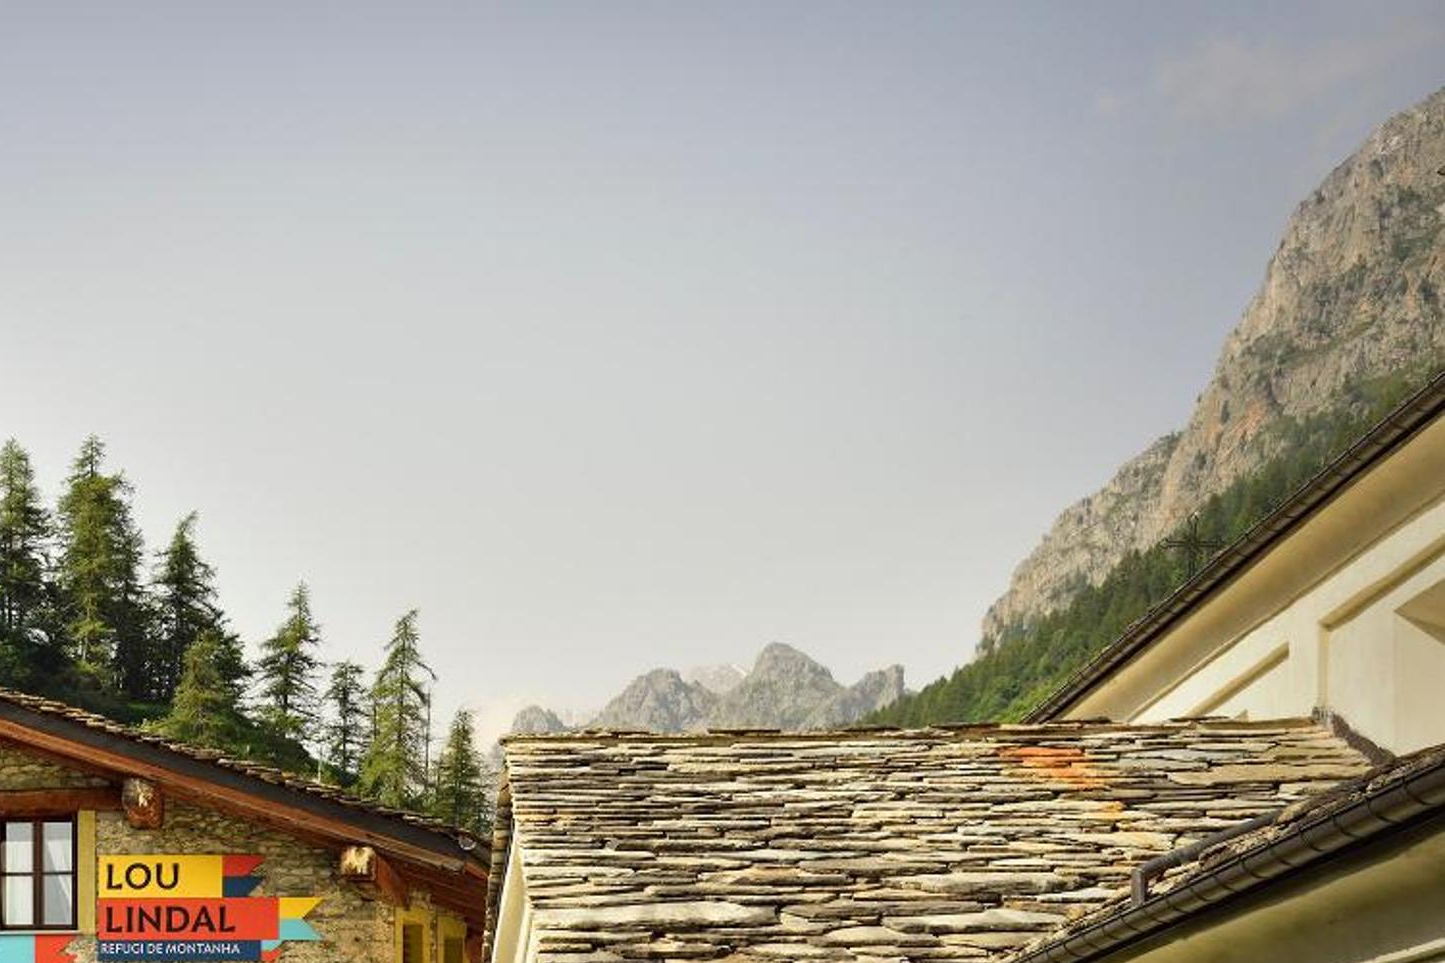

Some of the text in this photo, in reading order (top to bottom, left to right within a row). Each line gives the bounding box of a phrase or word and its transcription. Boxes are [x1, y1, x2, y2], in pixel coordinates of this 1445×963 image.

[106, 862, 179, 890] LOU
[106, 905, 236, 934] LINDAL
[100, 942, 241, 955] REFUGI DE MONTANHA
